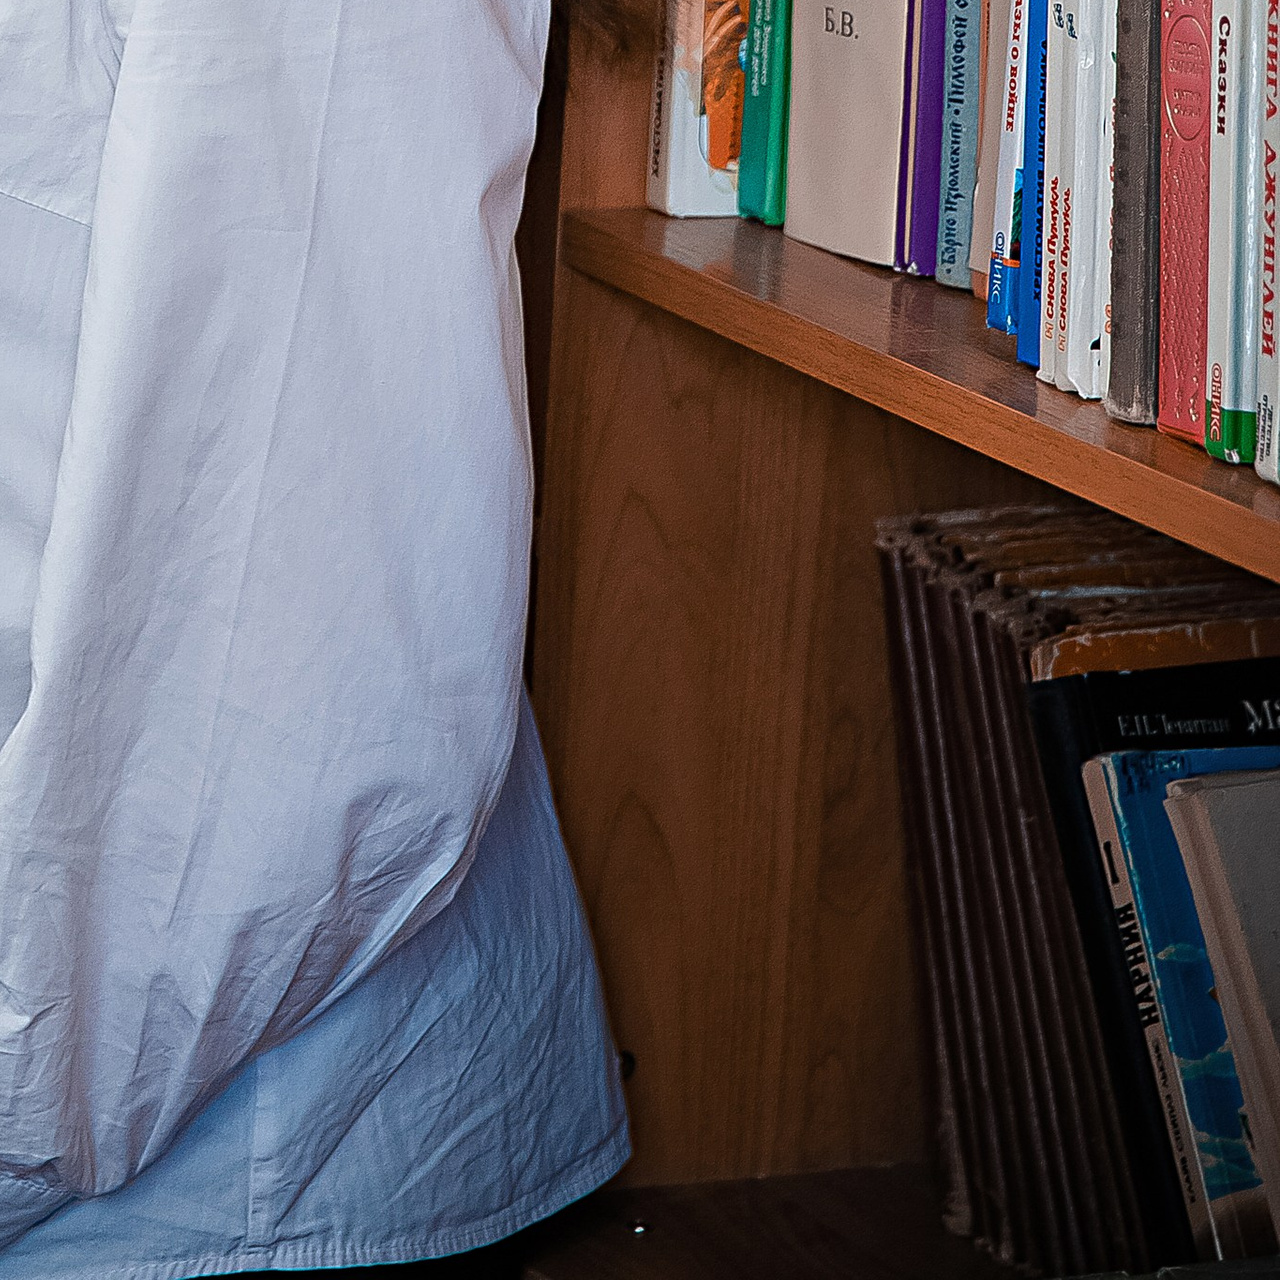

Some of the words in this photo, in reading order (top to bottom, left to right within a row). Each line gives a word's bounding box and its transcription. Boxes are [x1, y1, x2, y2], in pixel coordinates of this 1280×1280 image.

[824, 7, 859, 40] Б.В.
[946, 14, 968, 109] Тимофей
[1009, 47, 1020, 61] О
[1005, 65, 1020, 133] ВОЙНЕ
[1034, 39, 1048, 163] ШКОЛЬНИКА
[1216, 15, 1231, 135] Сказки
[943, 122, 964, 213] Изюмский
[941, 217, 961, 265] Борис
[1030, 169, 1045, 301] ХРЕСТОМАТИЯ
[1047, 175, 1060, 255] Пумукль
[1060, 187, 1071, 268] Пумукль
[1260, 139, 1280, 359] ДЖУНГЛЕЙ
[990, 231, 1006, 304] ОНИКС
[1209, 361, 1223, 443] ОНИКС
